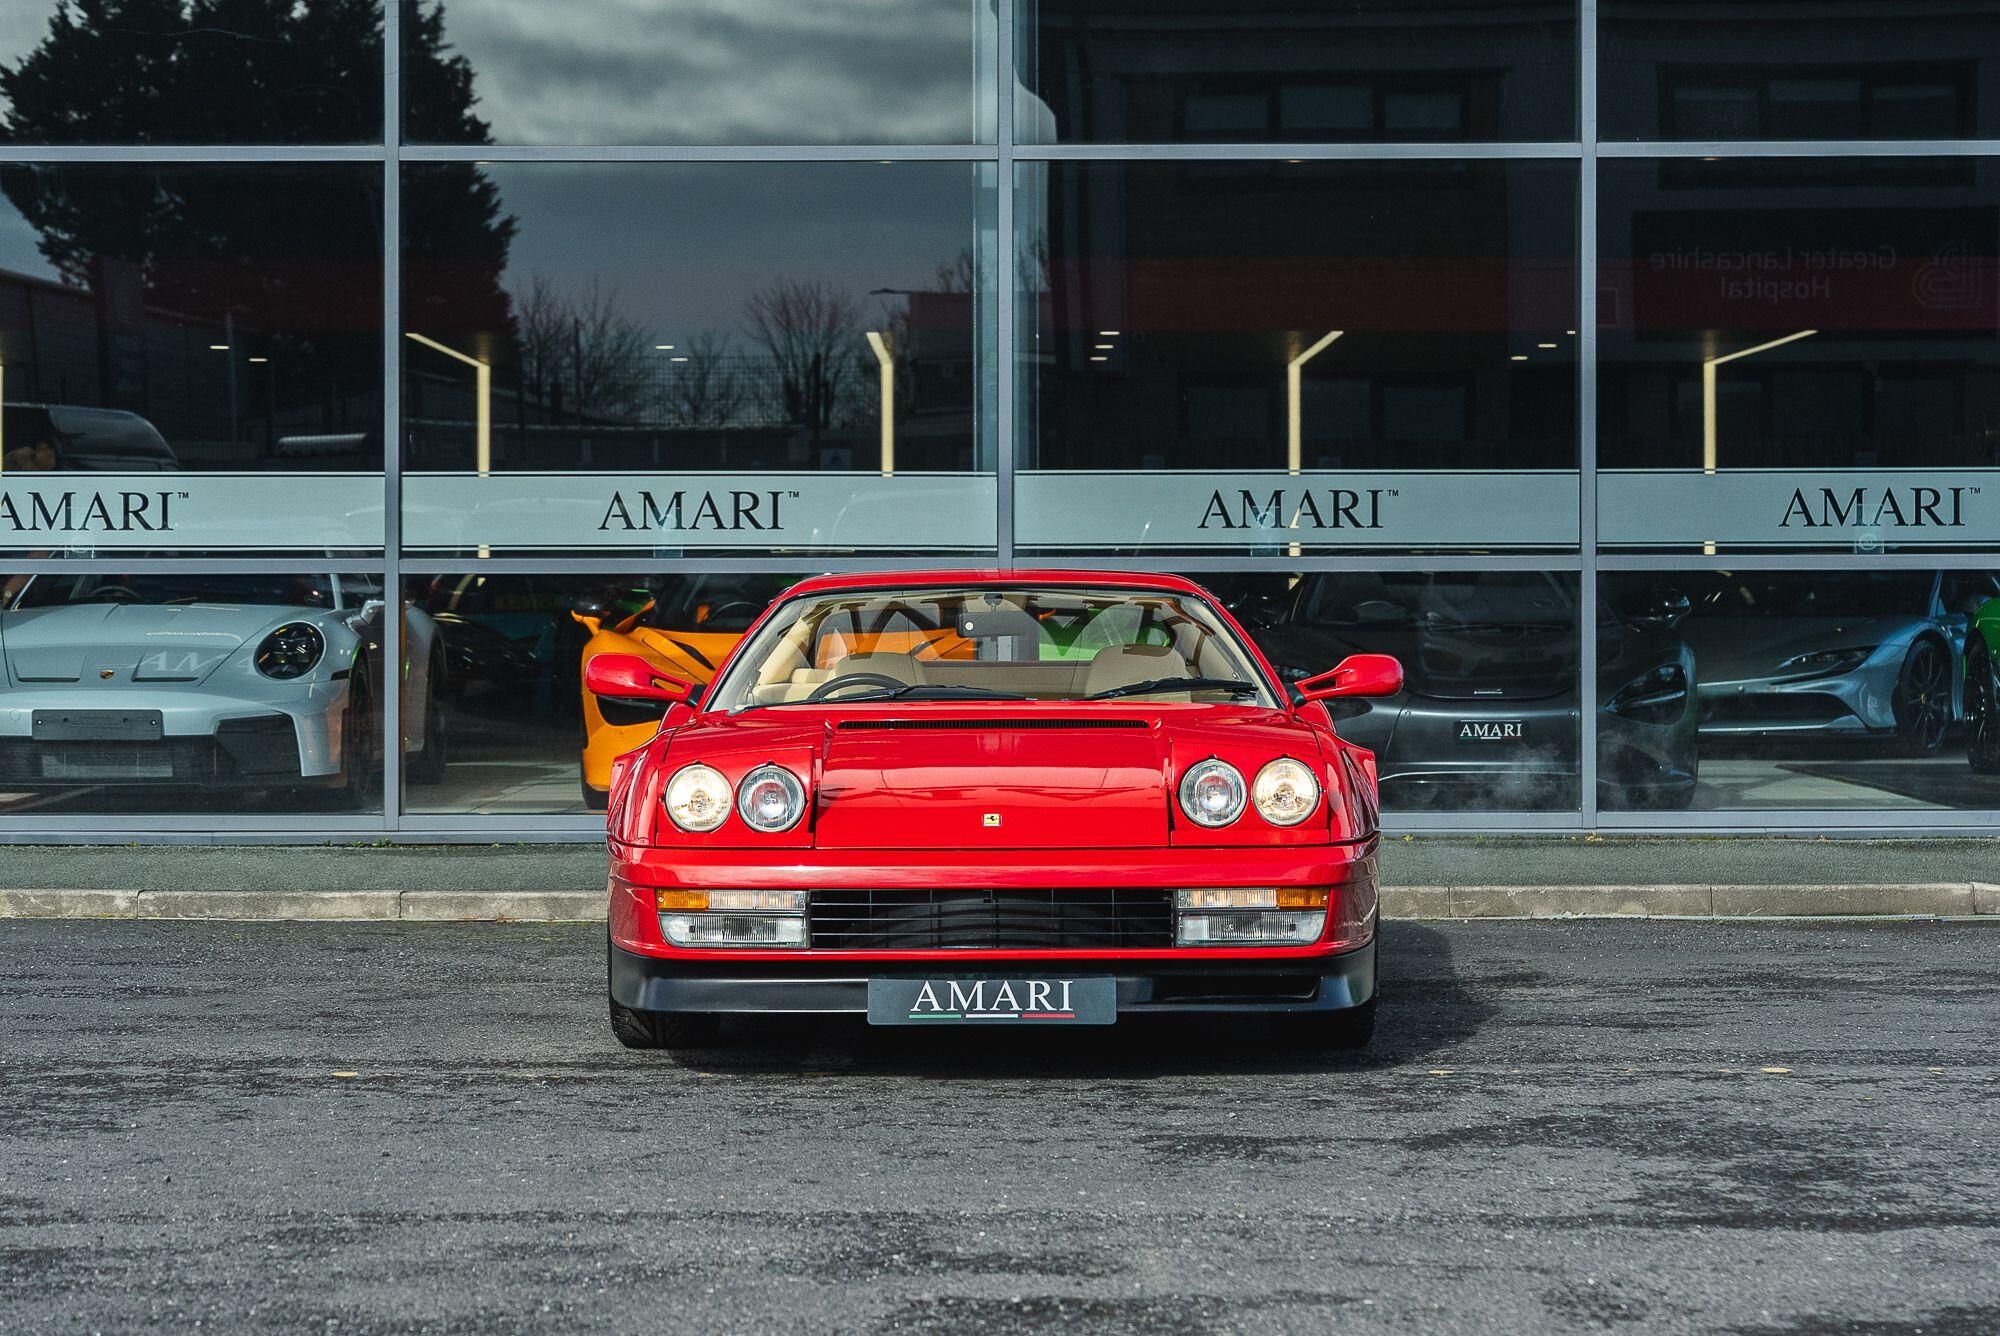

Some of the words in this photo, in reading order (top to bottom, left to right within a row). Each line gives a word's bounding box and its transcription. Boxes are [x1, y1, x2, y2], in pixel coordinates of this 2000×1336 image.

[597, 490, 784, 530] AMARI
[1197, 488, 1384, 529] AMARI
[1778, 487, 1966, 527] AMARI
[1459, 723, 1522, 737] AMARI
[910, 979, 1074, 1012] AMARI
